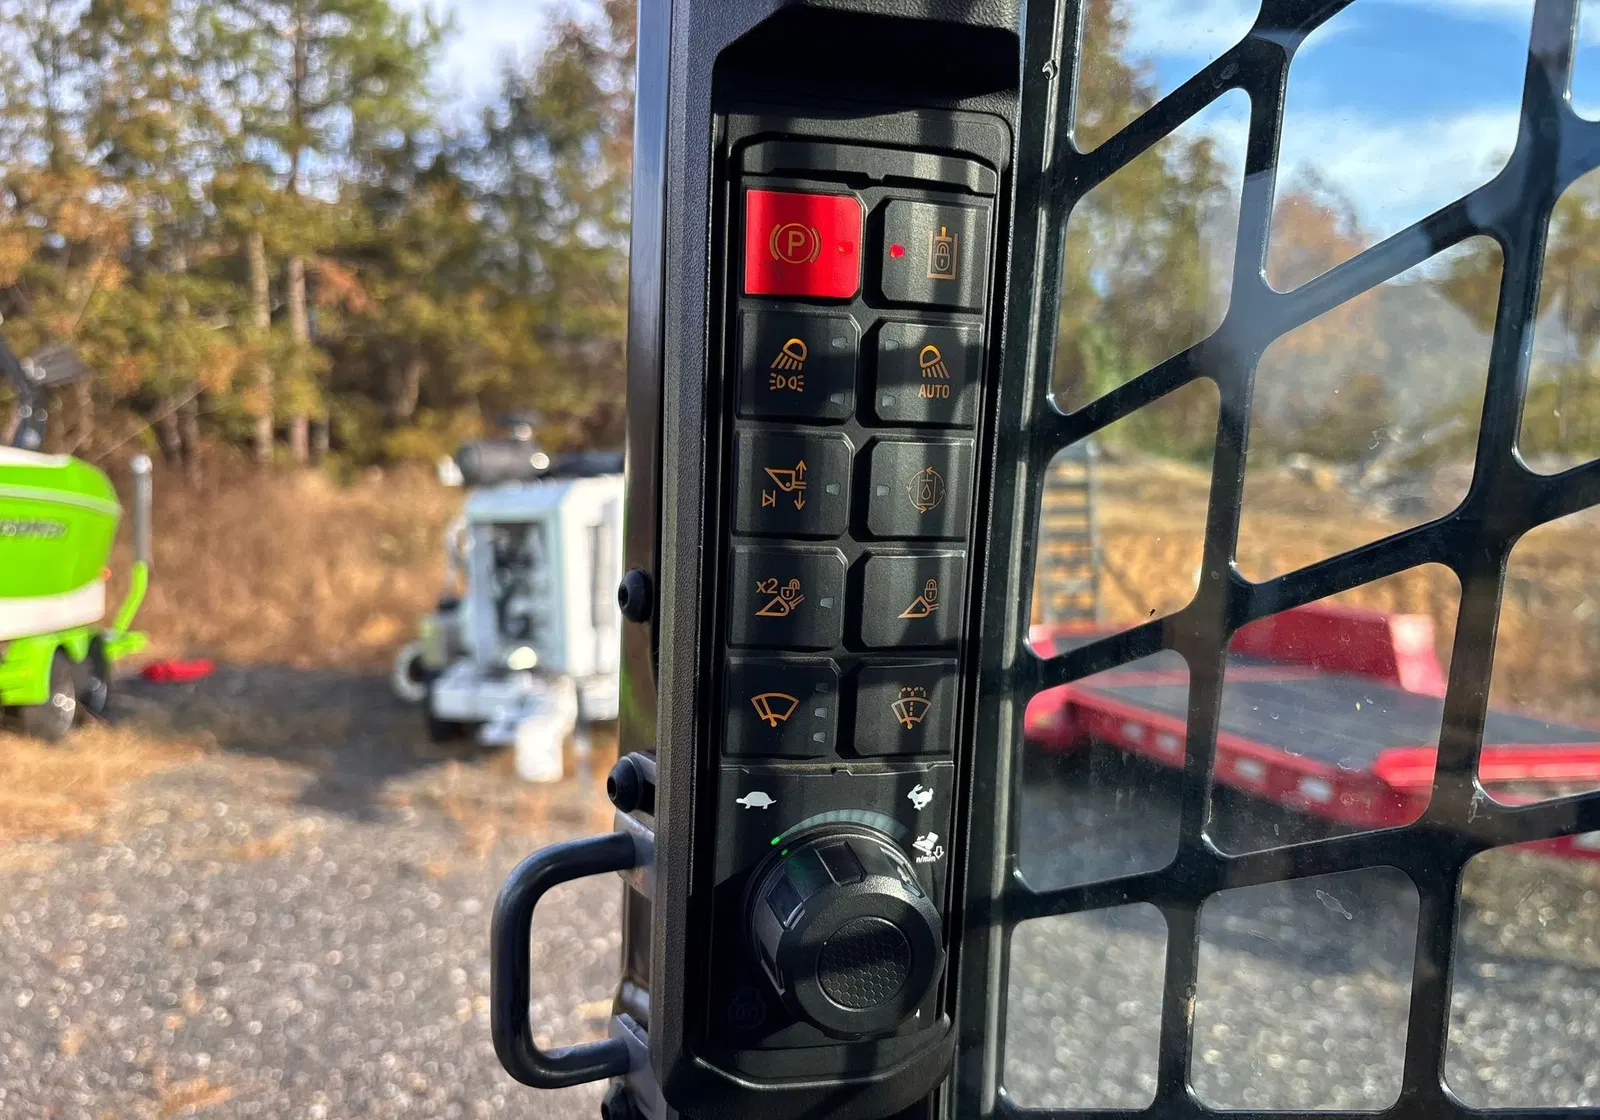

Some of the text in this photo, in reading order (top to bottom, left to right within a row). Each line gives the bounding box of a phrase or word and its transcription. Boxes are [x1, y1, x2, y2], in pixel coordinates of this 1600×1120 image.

[788, 230, 806, 257] P
[918, 384, 950, 399] AUTO
[756, 578, 778, 594] x2
[915, 855, 936, 863] n/min
